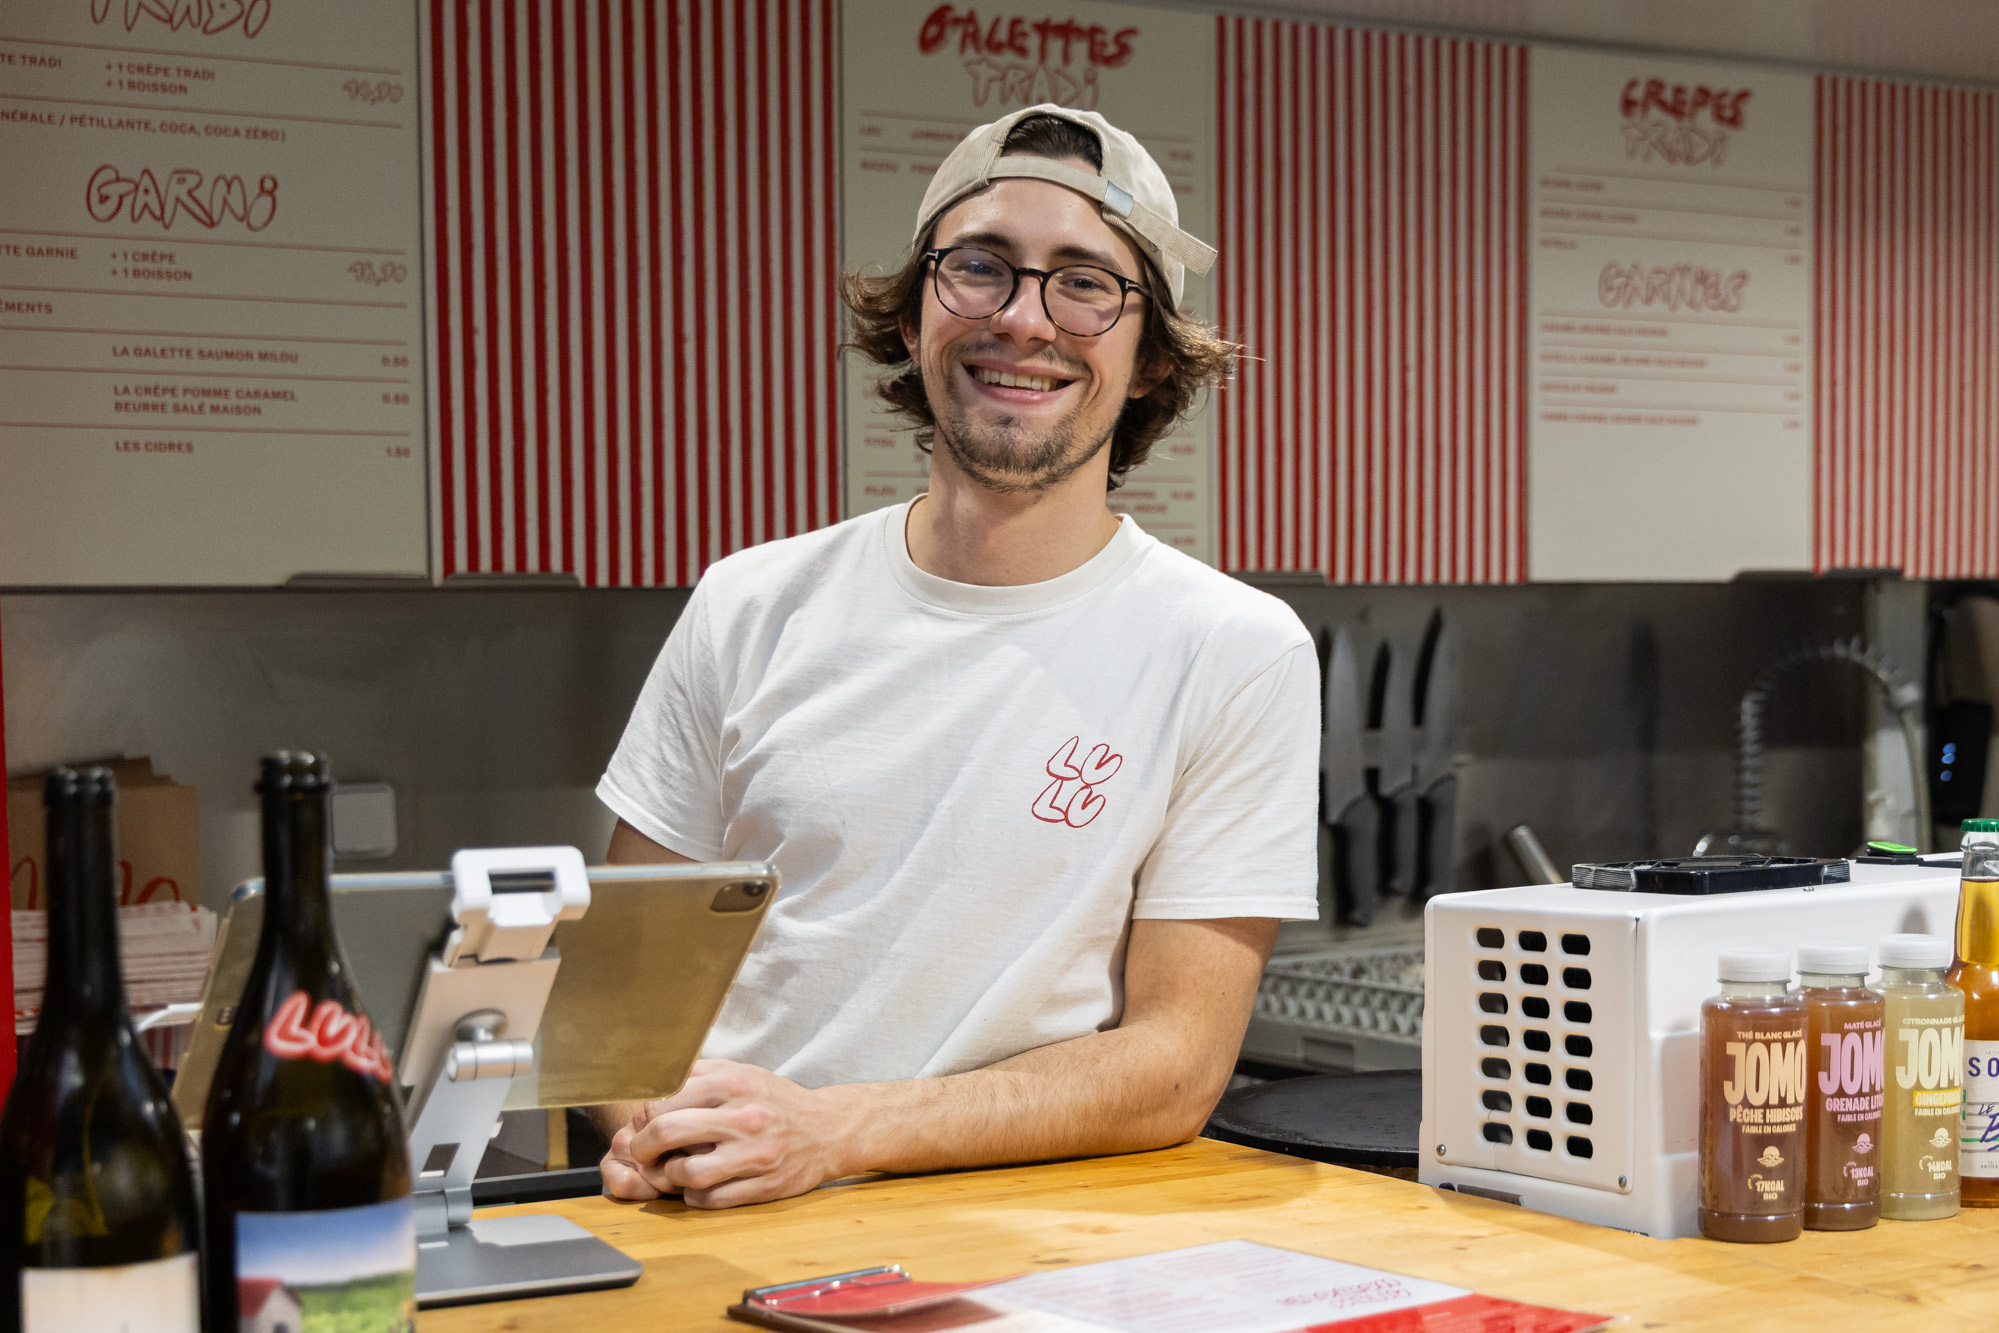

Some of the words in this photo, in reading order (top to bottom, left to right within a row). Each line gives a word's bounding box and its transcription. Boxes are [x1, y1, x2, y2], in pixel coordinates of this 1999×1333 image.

[21, 54, 62, 69] TRADI
[127, 61, 171, 77] CRÊPE
[175, 66, 216, 81] TRADI
[127, 80, 188, 95] BOISSON
[204, 122, 241, 139] COCA
[25, 245, 77, 260] GARNIE
[132, 250, 174, 264] CRÊPE
[132, 267, 192, 281] BOISSON
[112, 345, 129, 358] LA
[133, 346, 193, 360] GALETTE
[197, 348, 254, 362] SAUMON
[113, 384, 131, 397] LA
[134, 383, 178, 398] CRÊPE
[182, 386, 231, 400] POMME
[235, 388, 297, 402] CARAMEL
[114, 401, 168, 414] BEURRE
[172, 402, 206, 415] SALÉ
[209, 404, 262, 416] MAISON
[115, 440, 141, 453] LES
[144, 441, 194, 454] CIDRES
[1844, 1020, 1864, 1030] MATÉ
[1736, 1030, 1753, 1040] THÉ
[1755, 1031, 1782, 1040] BLANC
[1723, 1039, 1807, 1106] JOMO
[1825, 1096, 1869, 1112] GRENADE
[1729, 1104, 1764, 1122] PÊCHE
[1766, 1106, 1803, 1123] HIBISCUS
[1742, 1125, 1763, 1134] FAIBLE
[1763, 1125, 1771, 1134] EN
[1857, 1178, 1869, 1187] BIO
[1933, 1172, 1946, 1180] BIO
[1755, 1180, 1785, 1192] 17KCAL
[1763, 1193, 1778, 1201] BIO
